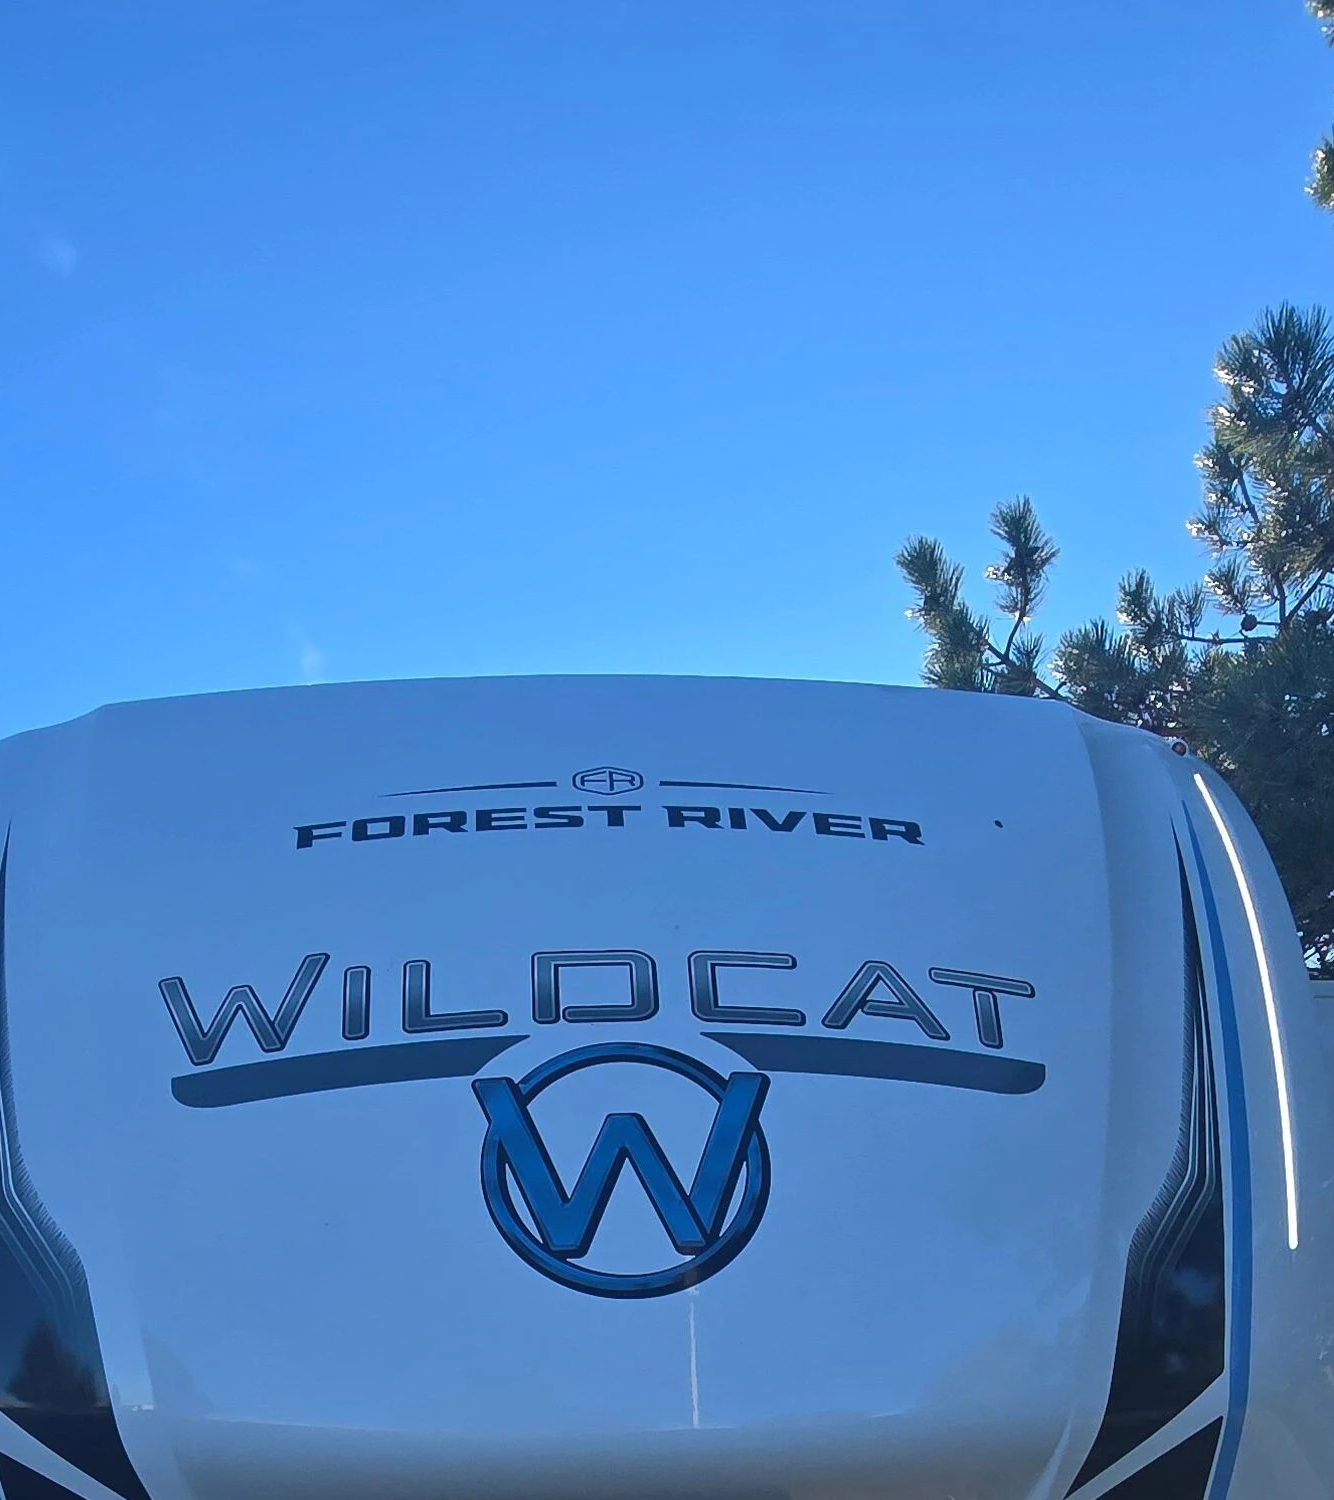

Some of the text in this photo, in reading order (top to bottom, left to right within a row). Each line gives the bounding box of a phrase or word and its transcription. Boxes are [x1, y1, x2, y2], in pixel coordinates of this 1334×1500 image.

[580, 770, 636, 792] FR
[293, 805, 925, 850] FOREST RIVER
[157, 948, 1035, 1065] WILDCAT
[471, 1069, 770, 1258] W
